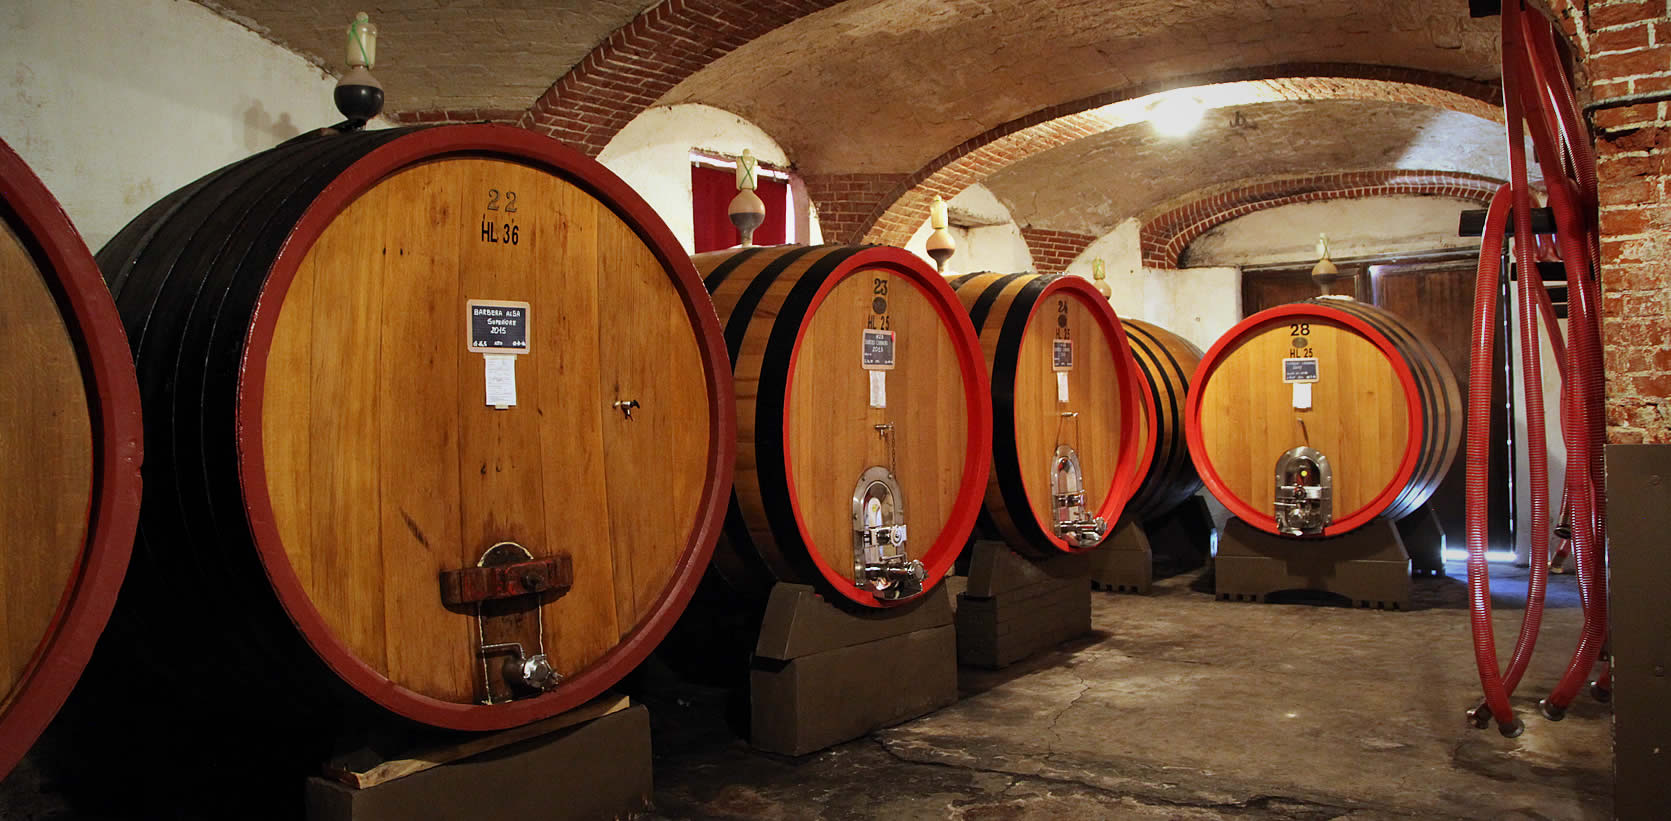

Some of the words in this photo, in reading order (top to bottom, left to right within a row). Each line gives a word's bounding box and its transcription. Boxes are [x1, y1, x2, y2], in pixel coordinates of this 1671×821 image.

[487, 188, 518, 213] 22
[481, 220, 498, 243] HL
[503, 223, 519, 246] 36
[873, 277, 888, 296] 23
[473, 308, 503, 317] BARBERA
[1289, 322, 1311, 337] 28
[1289, 348, 1301, 359] HL
[1303, 347, 1314, 358] 25
